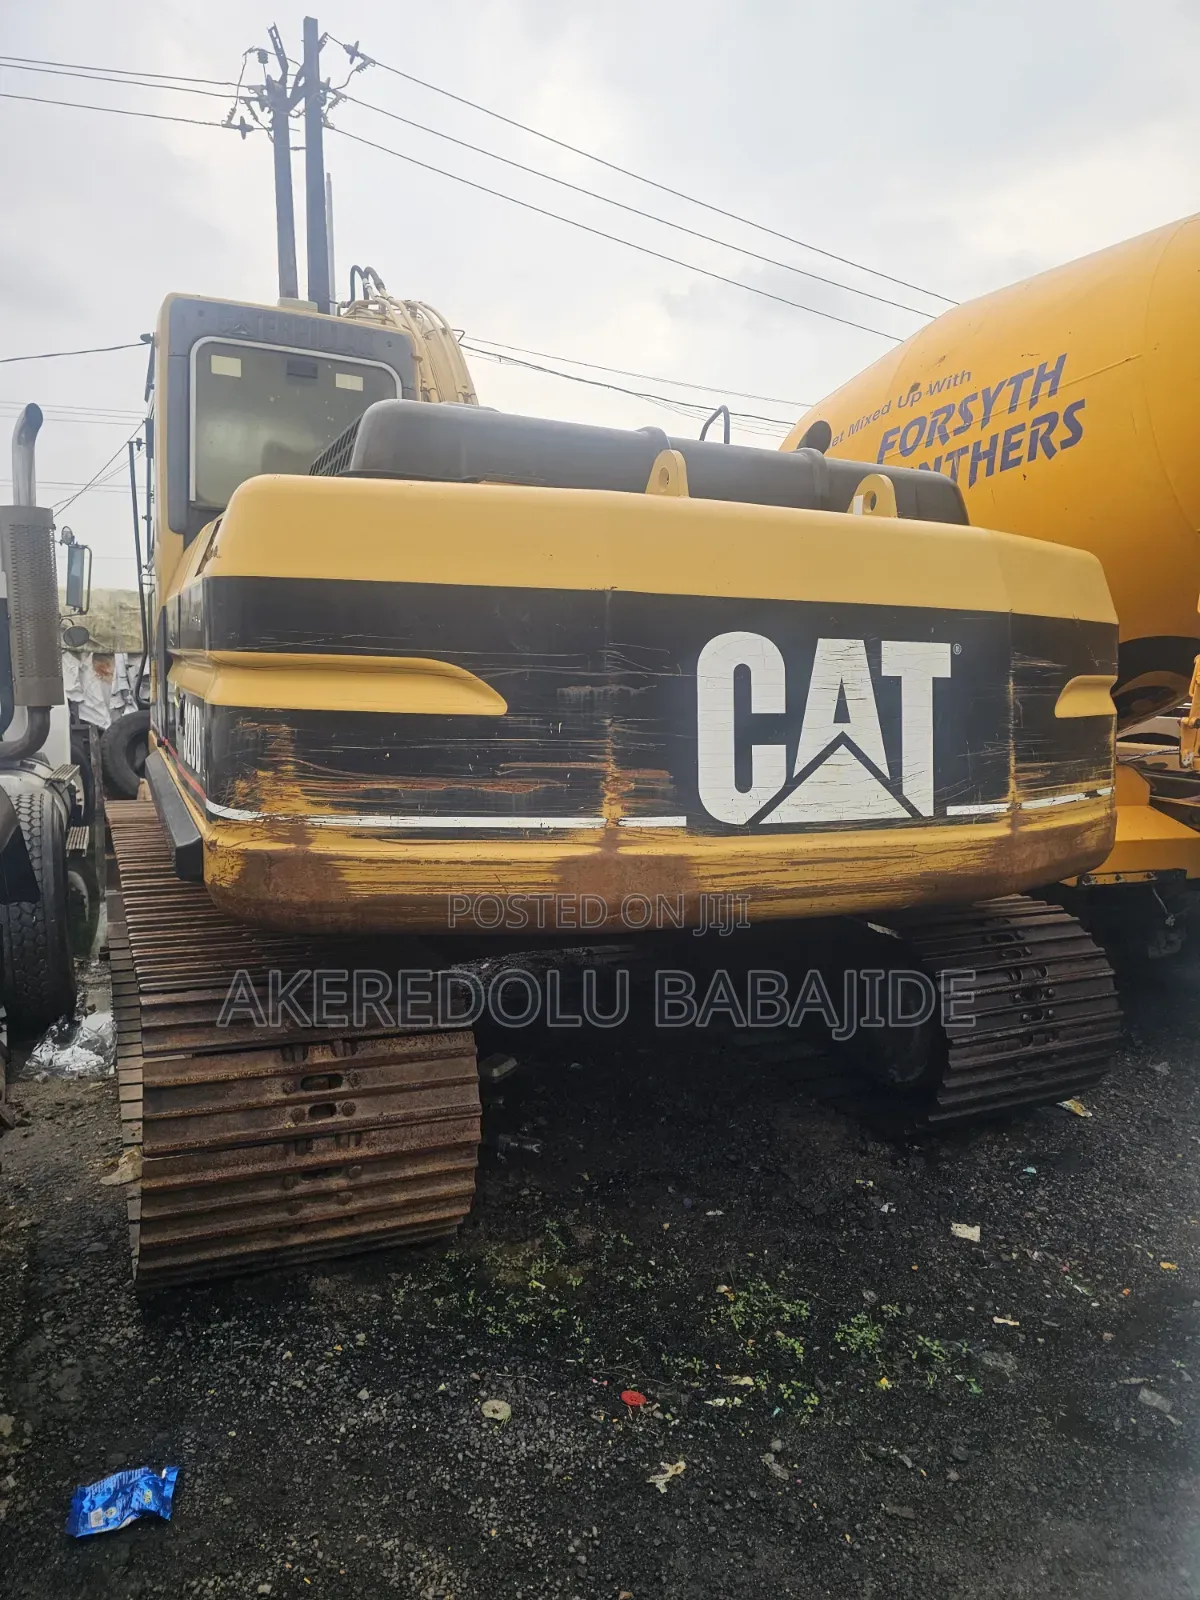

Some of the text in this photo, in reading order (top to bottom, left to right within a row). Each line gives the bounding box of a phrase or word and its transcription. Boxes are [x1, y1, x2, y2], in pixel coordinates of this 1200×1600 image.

[831, 370, 972, 447] et Mixed Up With
[877, 353, 1068, 464] FORSYTH
[697, 631, 951, 825] CAT
